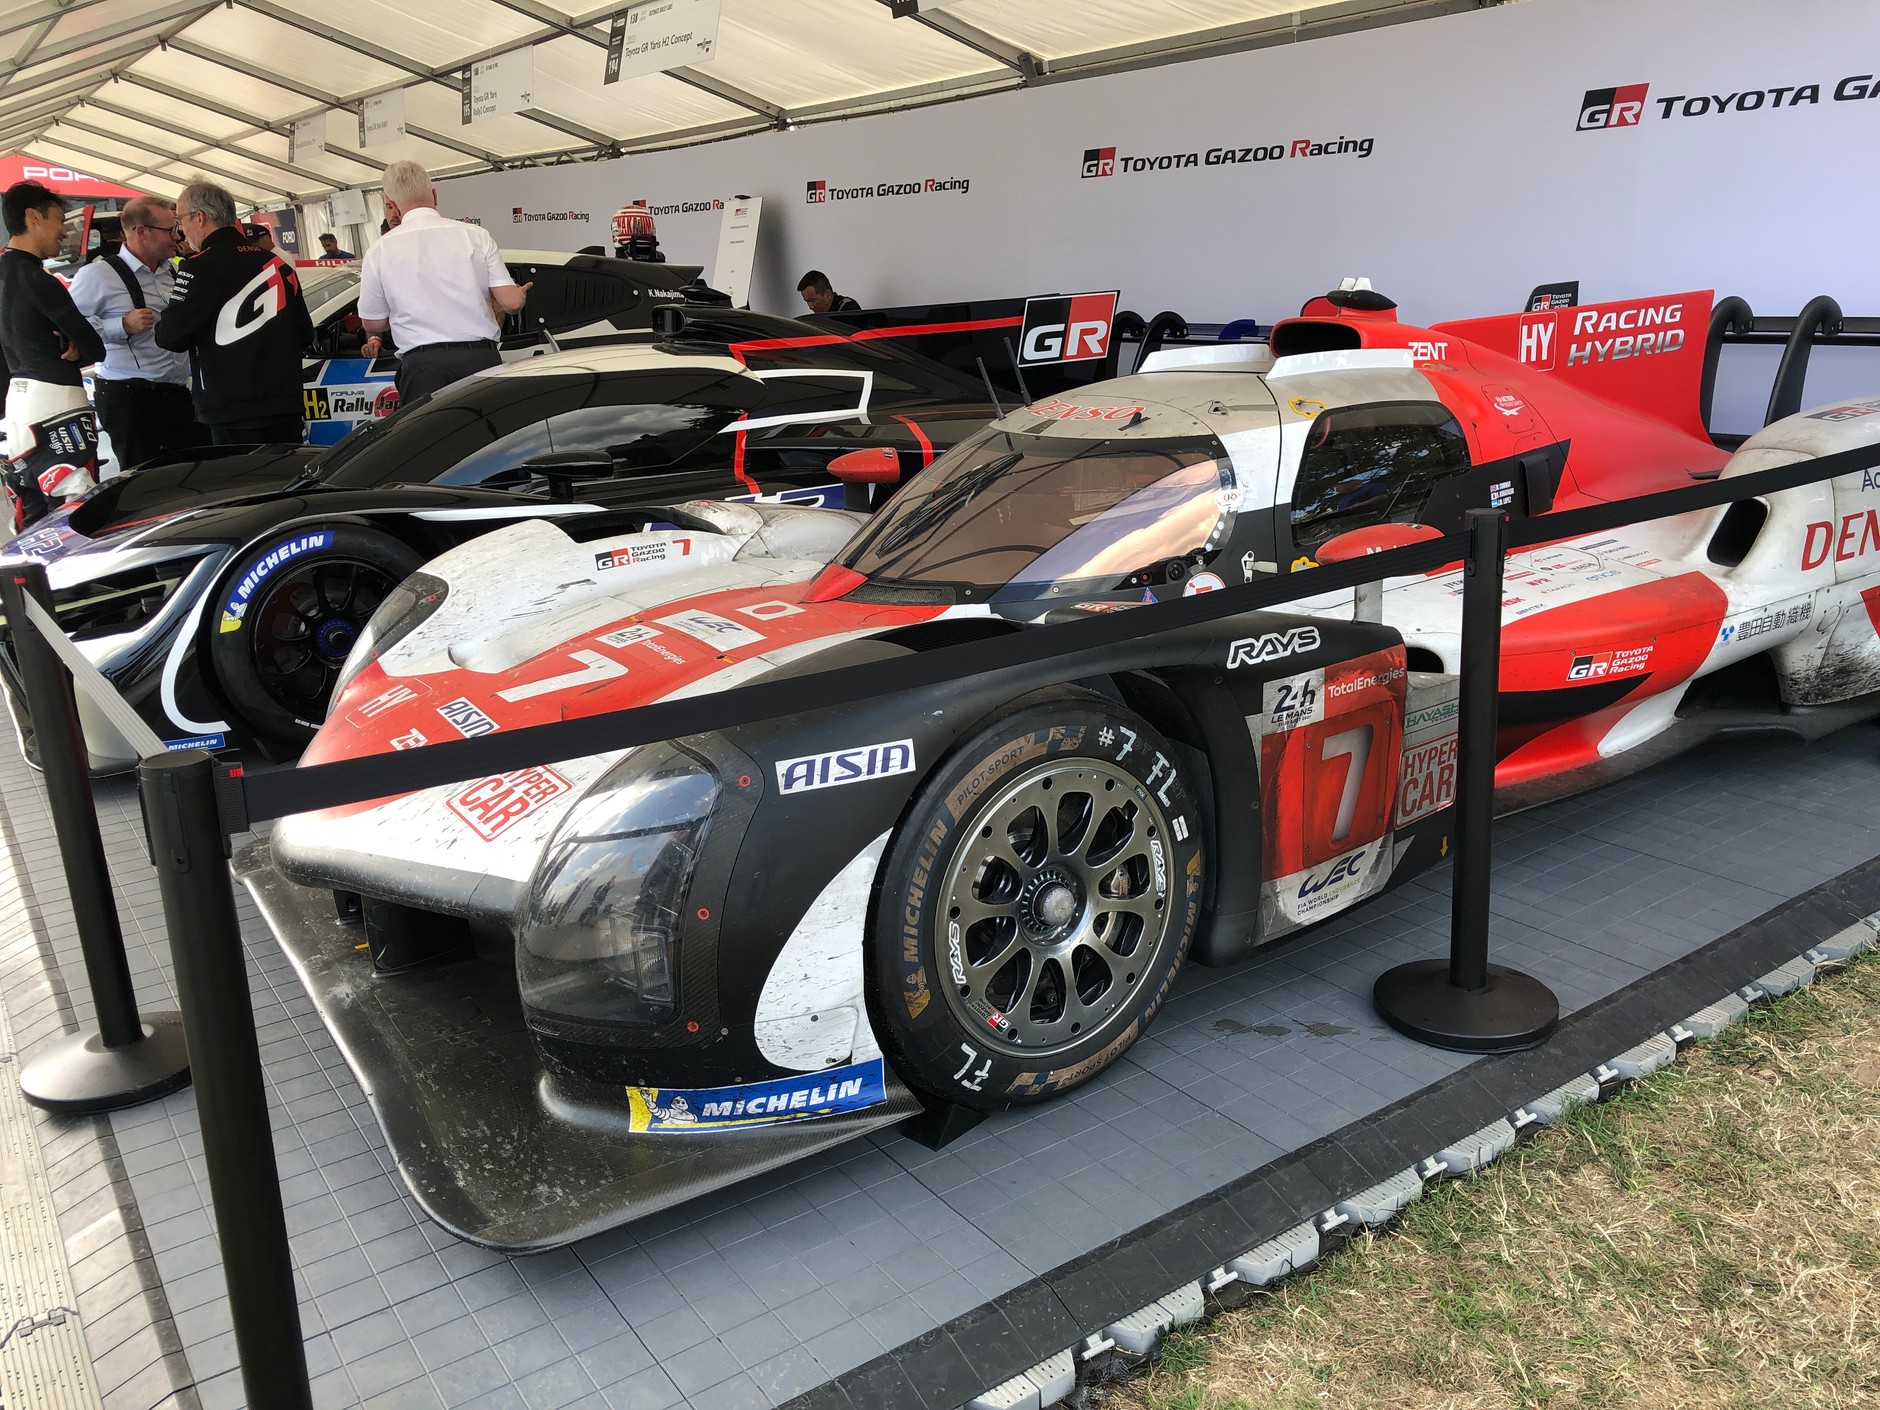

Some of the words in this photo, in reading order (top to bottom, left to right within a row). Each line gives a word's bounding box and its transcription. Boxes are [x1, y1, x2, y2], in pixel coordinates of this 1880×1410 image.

[625, 47, 640, 59] Toyota
[641, 42, 649, 53] GR
[650, 39, 661, 51] Yaris
[662, 36, 669, 46] H2
[671, 32, 693, 44] Concept
[1656, 84, 1820, 119] TOYOTA
[1119, 153, 1199, 172] TOYOTA
[1204, 144, 1285, 166] GAZOO
[1290, 136, 1375, 160] Racing
[828, 187, 874, 201] TOYOTA
[876, 182, 922, 197] GAZOO
[924, 176, 970, 195] Racing
[524, 211, 546, 222] TOYOTA
[547, 211, 567, 221] GAZOO
[569, 210, 590, 223] Racing
[648, 203, 680, 215] TOYOTA
[682, 199, 711, 212] GAZOO
[282, 231, 296, 243] FORD
[1551, 292, 1572, 300] TOYOTA
[1573, 303, 1683, 336] RACING
[1023, 320, 1108, 361] GR
[1408, 341, 1448, 361] ZENT
[1521, 322, 1555, 363] HY
[1567, 329, 1686, 367] HYBRID
[303, 389, 329, 419] H2
[333, 397, 374, 415] Rally
[1025, 399, 1147, 421] DENSO
[58, 426, 76, 453] AISIN
[630, 541, 667, 552] TOYOTA
[631, 548, 666, 558] GAZOO
[632, 553, 667, 564] Racing
[672, 539, 692, 557] 7
[238, 534, 325, 600] MICHELIN
[1736, 601, 1813, 641] 豊田自動織機
[640, 638, 687, 665] TotalEnergies
[1227, 626, 1320, 669] RAYS
[1612, 654, 1648, 667] GAZOO
[1615, 645, 1653, 658] TOYOTA
[496, 648, 629, 703] 7
[1328, 667, 1405, 699] TotalEnergies
[1609, 662, 1645, 674] Racing
[358, 684, 418, 718] HY
[1273, 678, 1316, 715] 24h
[440, 701, 496, 738] AISIN
[1271, 714, 1283, 724] LE
[1285, 706, 1313, 721] MANS
[168, 738, 218, 751] MICHELIN
[1098, 725, 1137, 761] #7
[1404, 738, 1458, 780] HYPER
[783, 744, 911, 792] AISIN
[957, 770, 986, 806] PILOT
[988, 745, 1024, 775] SPORT
[1321, 724, 1373, 844] 7
[458, 777, 531, 833] CAR
[1401, 763, 1455, 818] CAR
[1150, 839, 1167, 898] RAYS
[1298, 850, 1366, 899] WEC
[902, 818, 948, 964] MICHELIN
[1298, 894, 1340, 916] CHAMPIONSHIP
[1308, 893, 1328, 905] WORLD
[1328, 878, 1360, 897] ENDURANCE
[947, 921, 966, 984] RAYS
[1143, 902, 1197, 1023] MICHELIN
[1104, 1033, 1133, 1060] PILOT
[702, 1077, 863, 1117] MICHELIN
